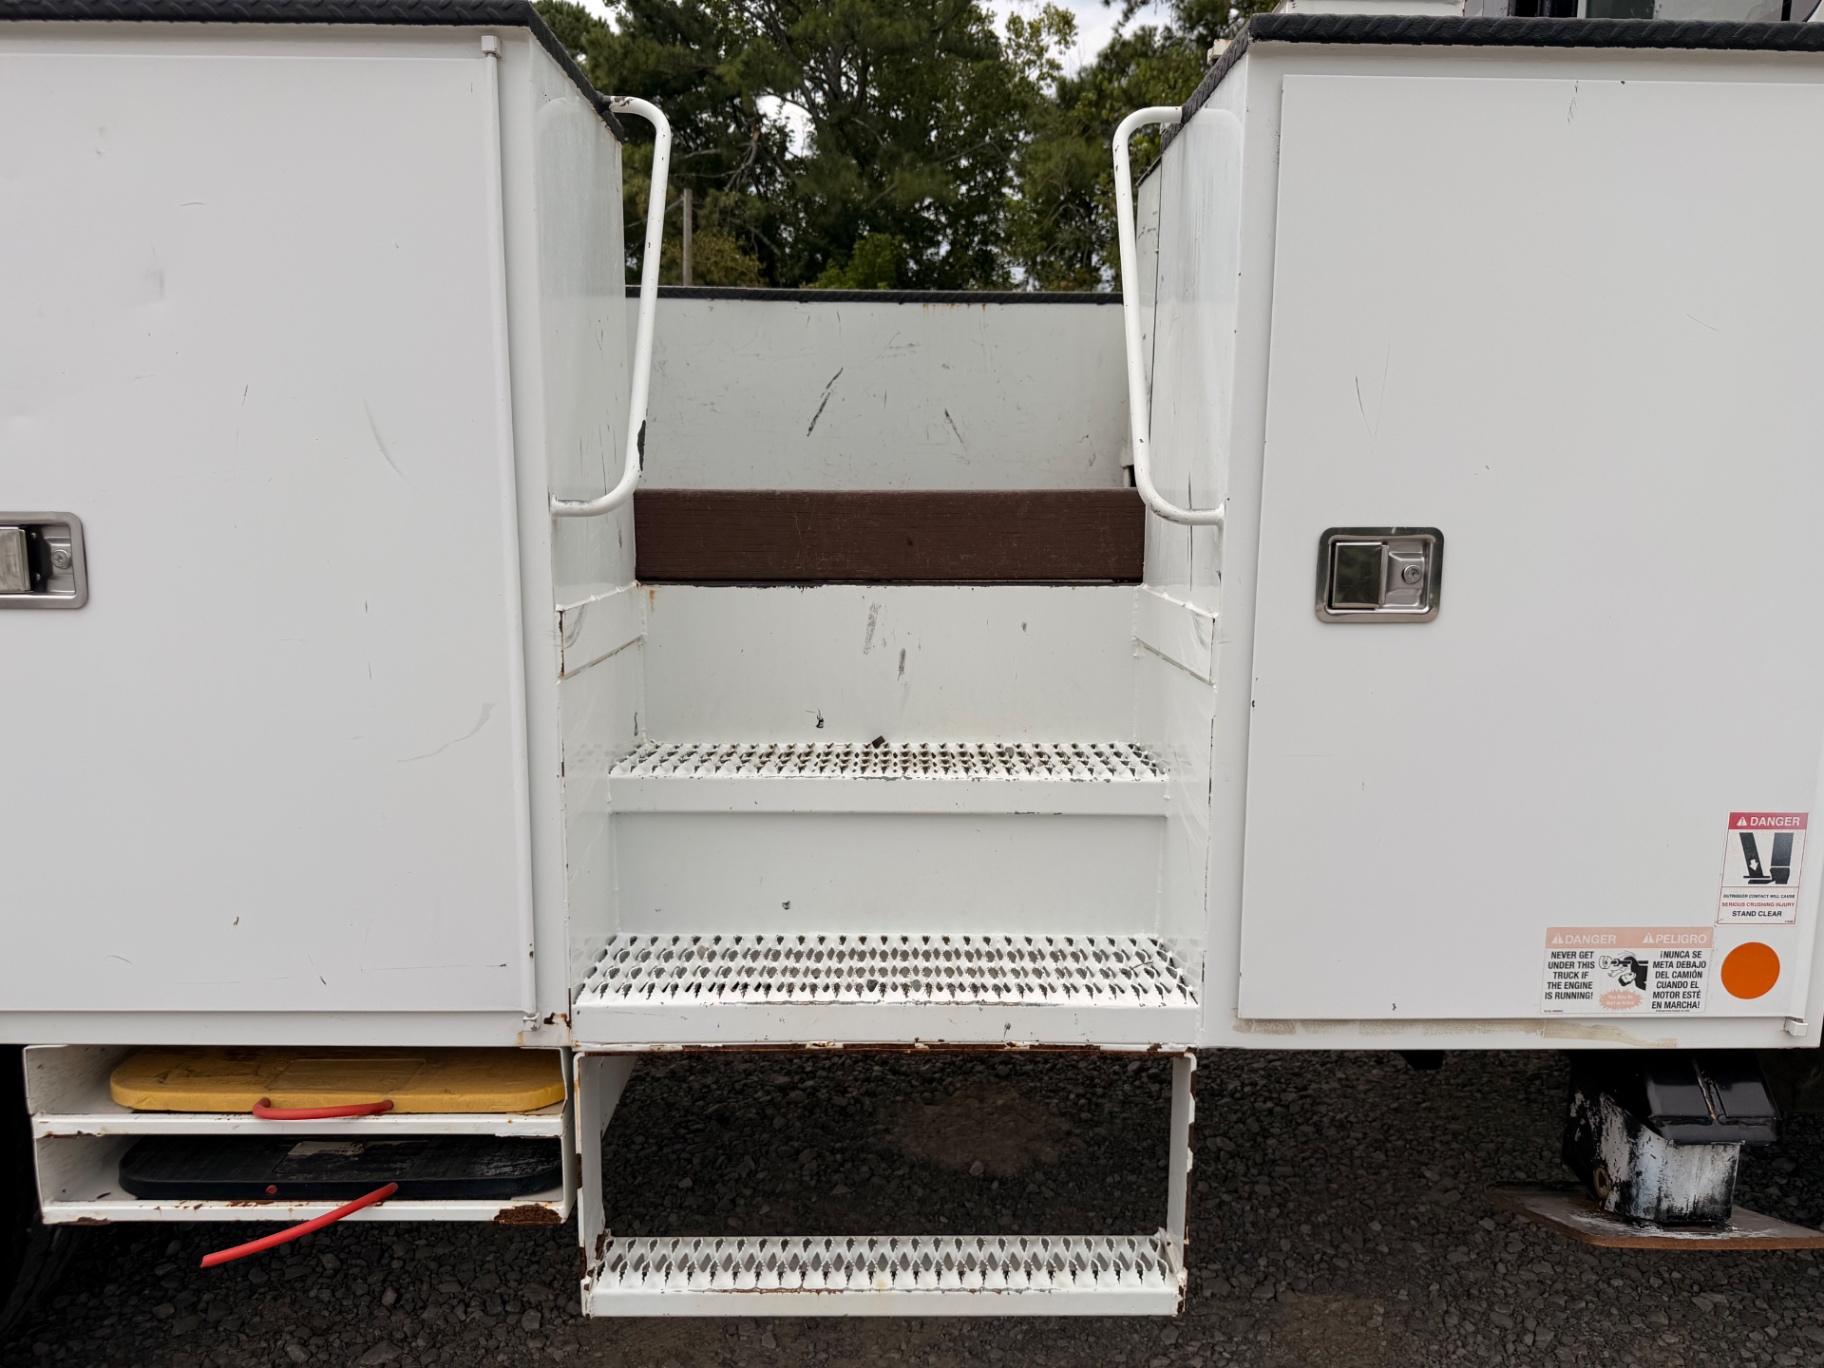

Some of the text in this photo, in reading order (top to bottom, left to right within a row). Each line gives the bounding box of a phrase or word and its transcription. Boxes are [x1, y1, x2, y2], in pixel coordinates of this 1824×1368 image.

[1750, 817, 1800, 826] DANGER
[1565, 935, 1616, 944] DANGER
[1656, 934, 1707, 943] PELIGRO
[1551, 951, 1594, 959] NEVER GET
[1660, 951, 1690, 959] ¡NUNCA
[1548, 961, 1595, 969] UNDER THIS
[1553, 971, 1579, 979] TRUCK
[1671, 969, 1702, 978] CAMIÓN
[1564, 981, 1593, 989] ENGINE
[1656, 981, 1699, 989] CUANDO EL
[1653, 989, 1701, 999] MOTOR ESTÉ
[1664, 1001, 1700, 1009] MARCHA!
